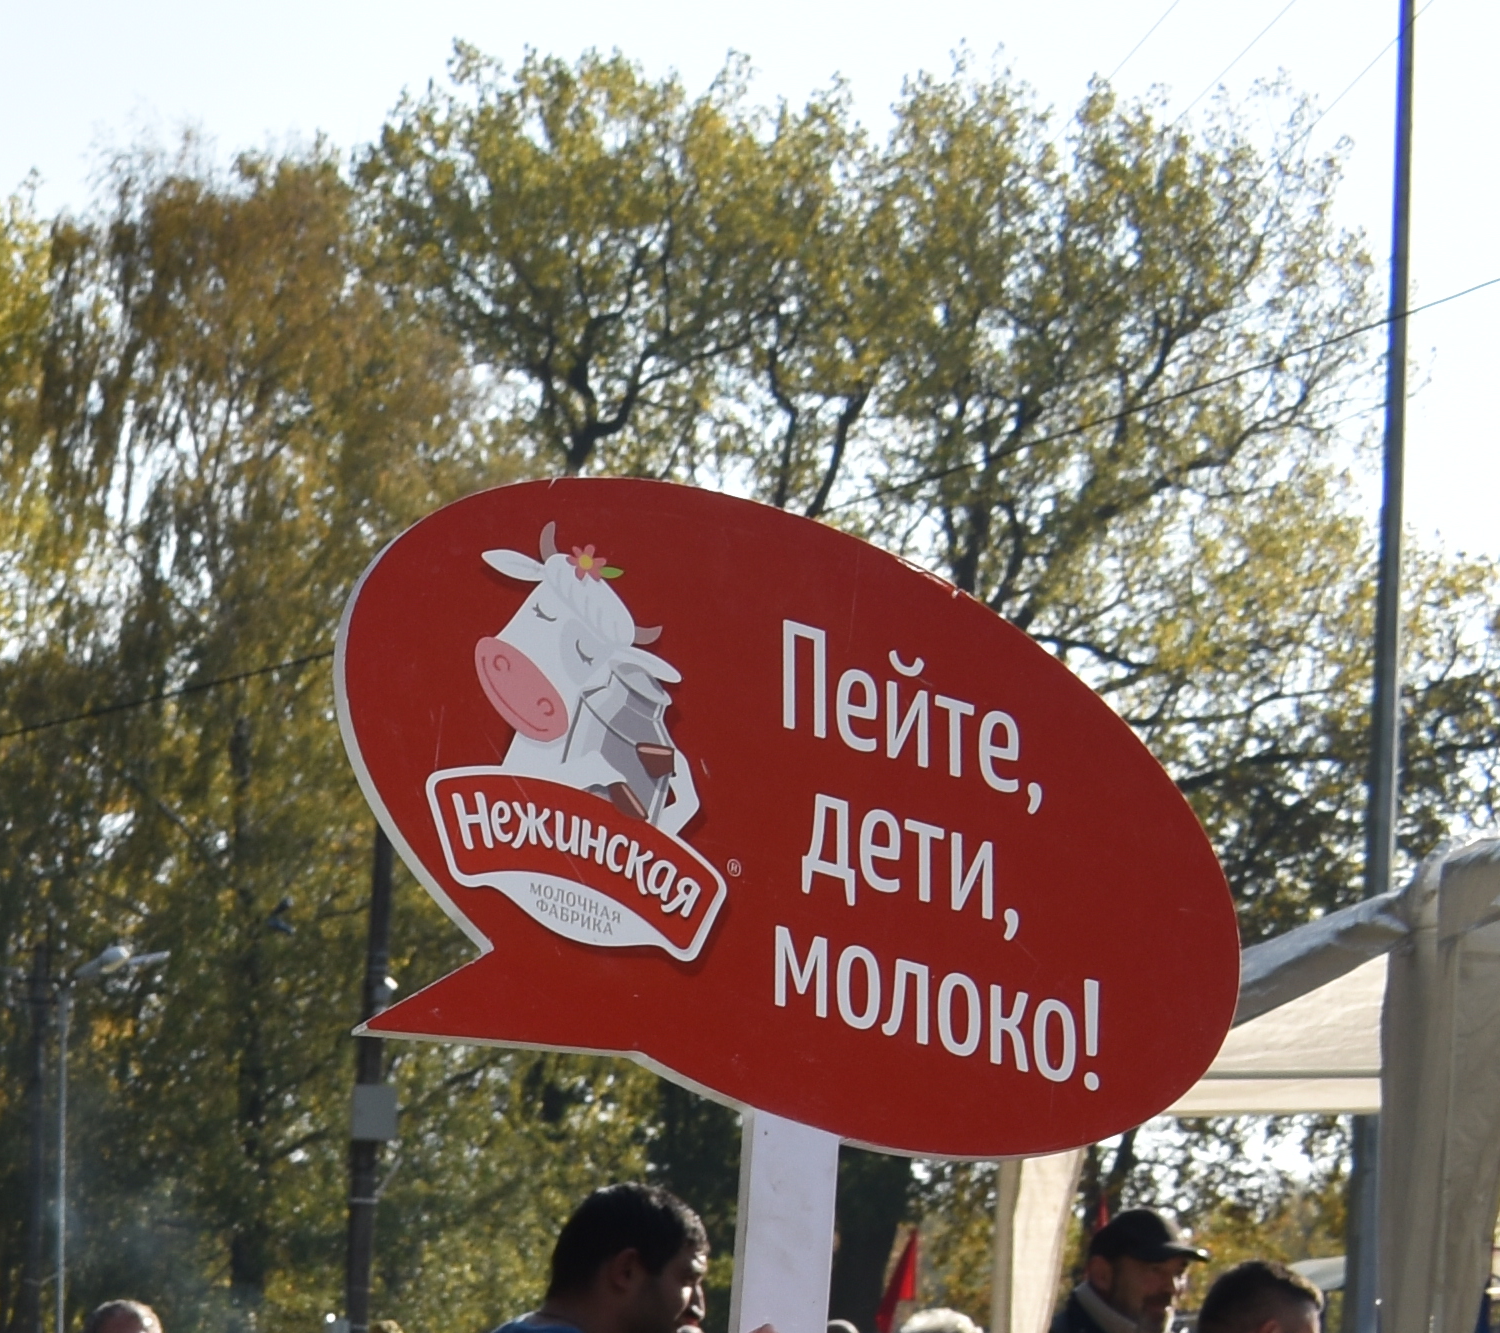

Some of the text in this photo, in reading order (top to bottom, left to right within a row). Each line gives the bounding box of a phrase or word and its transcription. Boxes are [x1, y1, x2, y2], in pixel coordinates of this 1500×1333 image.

[780, 617, 1044, 816] Пейте,
[451, 791, 701, 918] Нежинская
[529, 882, 622, 925] МОЛОЧНАЯ
[535, 899, 614, 936] ФАБРИКА
[800, 791, 1019, 944] дети,
[774, 923, 1102, 1093] молоко!
